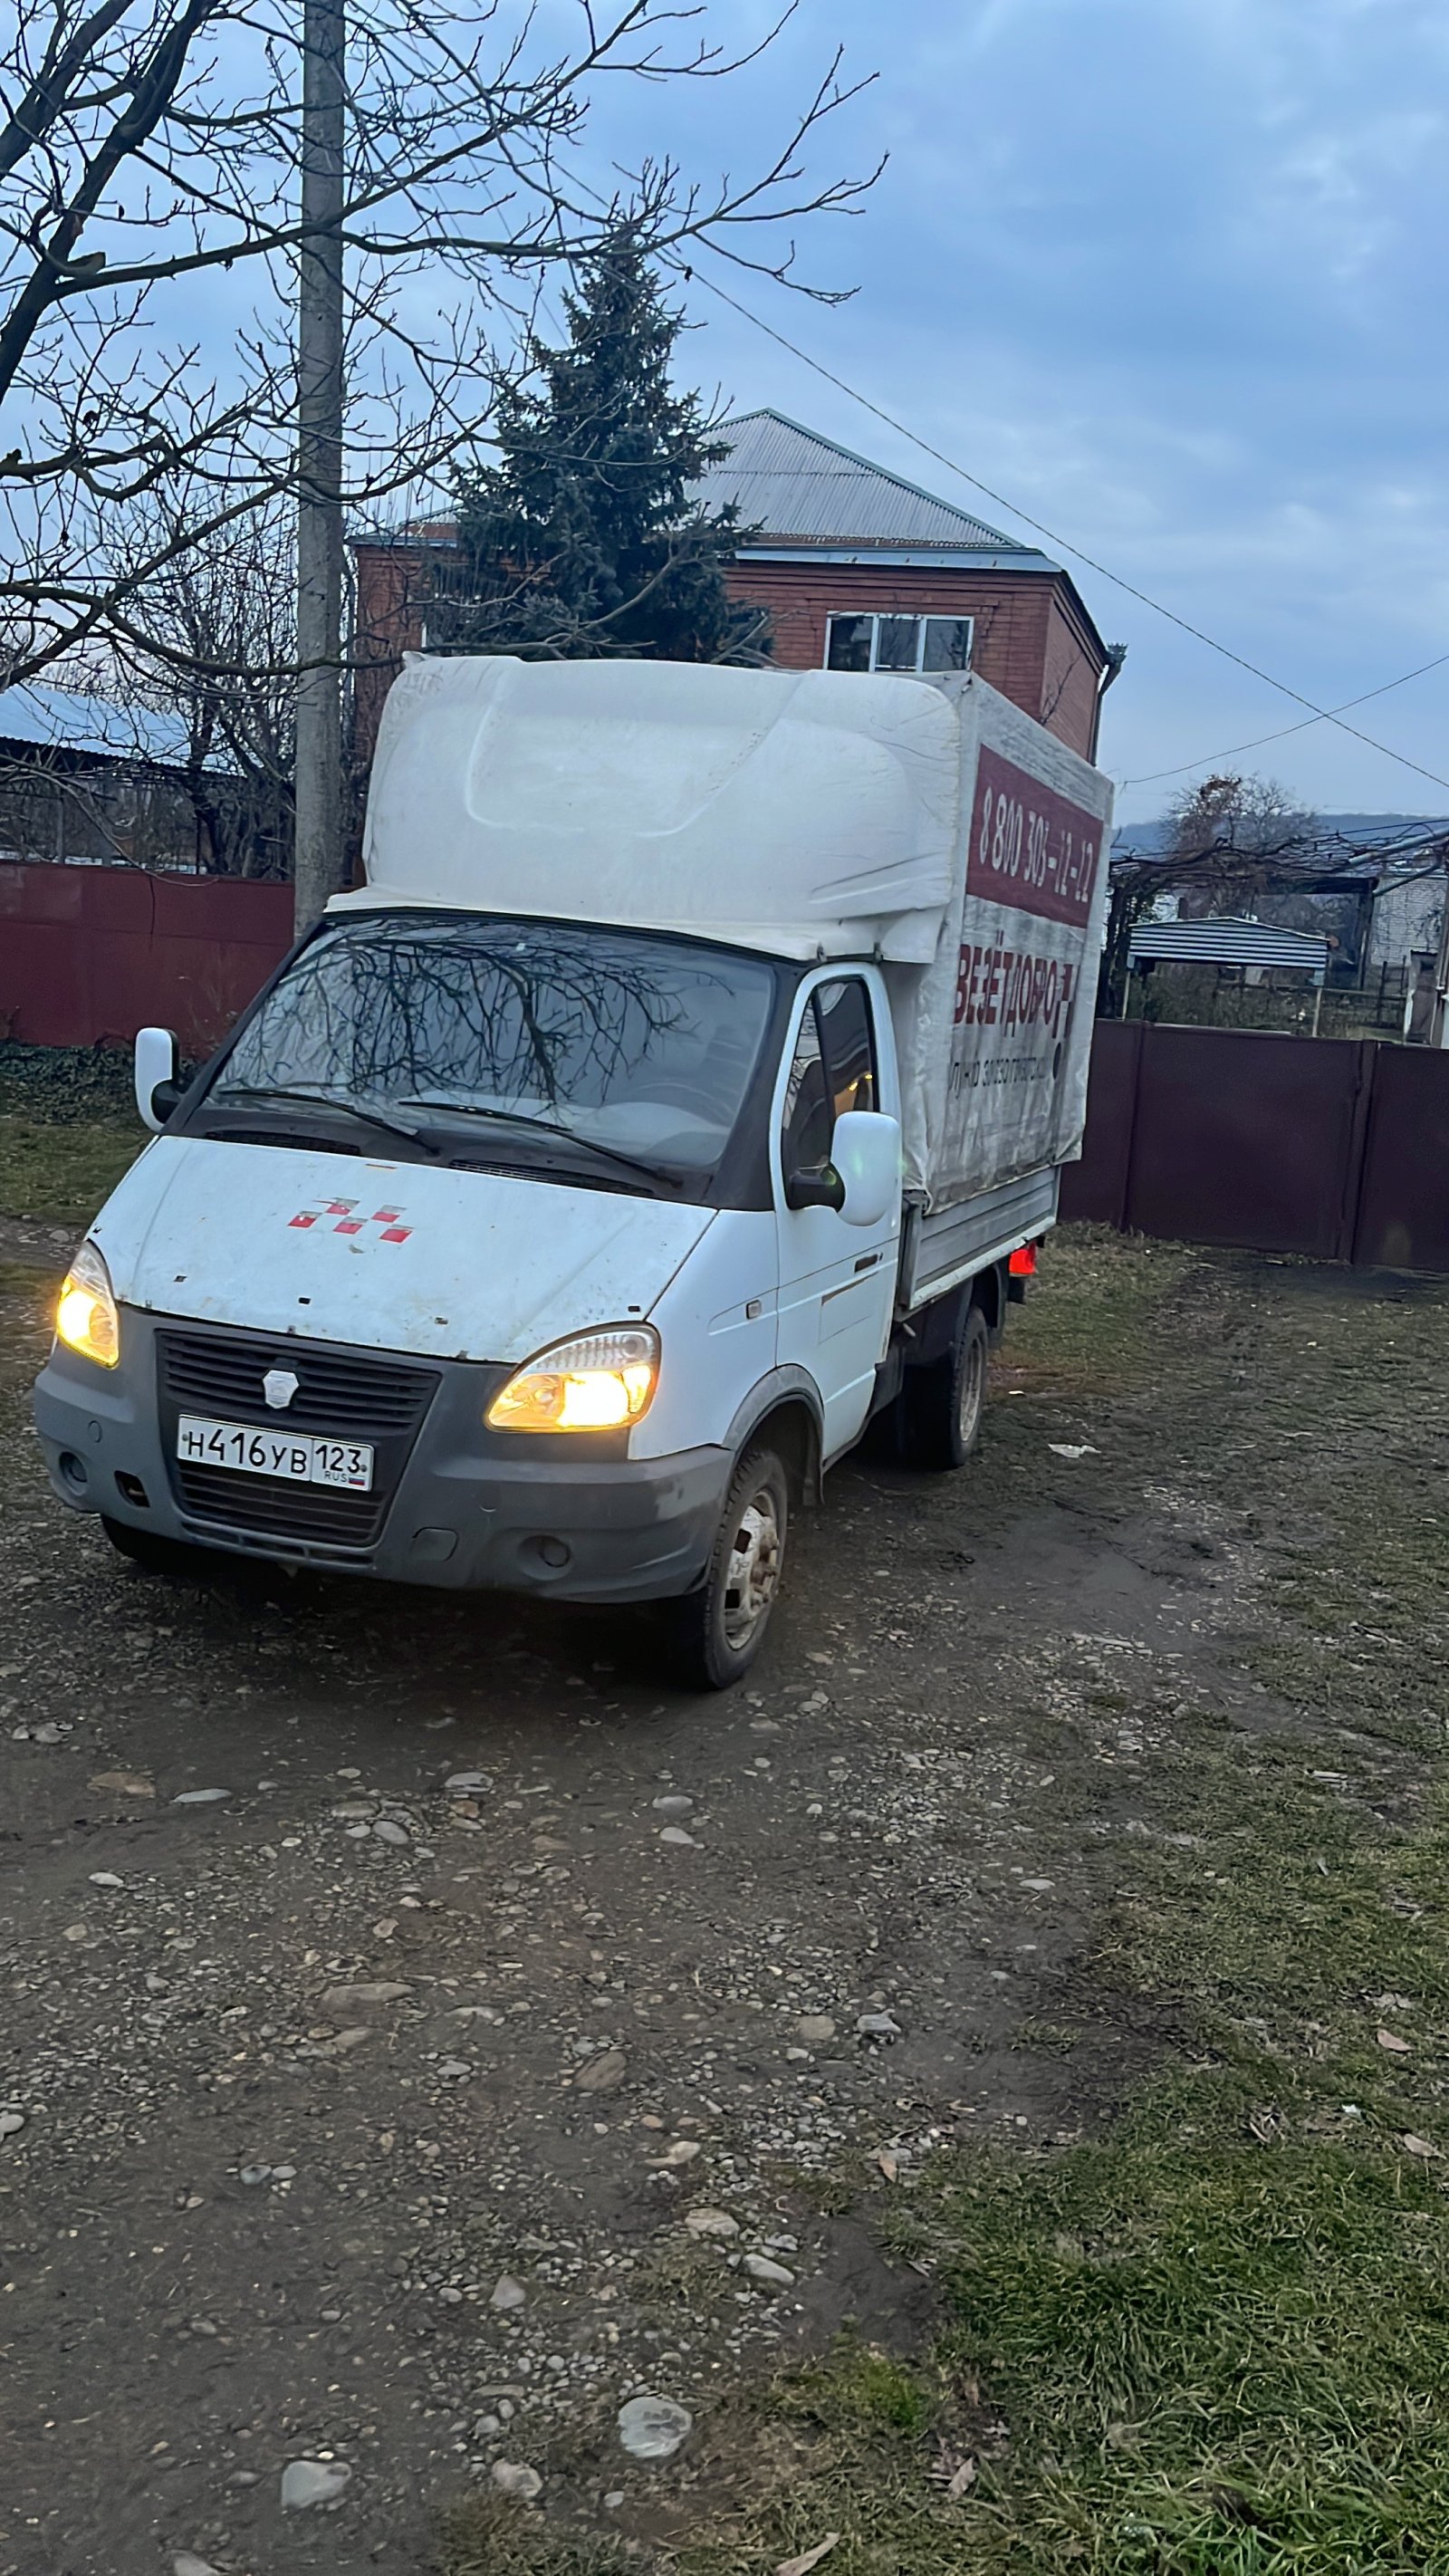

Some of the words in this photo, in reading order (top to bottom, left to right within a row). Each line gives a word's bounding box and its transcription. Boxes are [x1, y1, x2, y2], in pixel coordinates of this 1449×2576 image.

[980, 786, 993, 865] 8
[992, 793, 1023, 877] 800
[315, 1444, 361, 1474] 123
[324, 1470, 348, 1484] RUS
